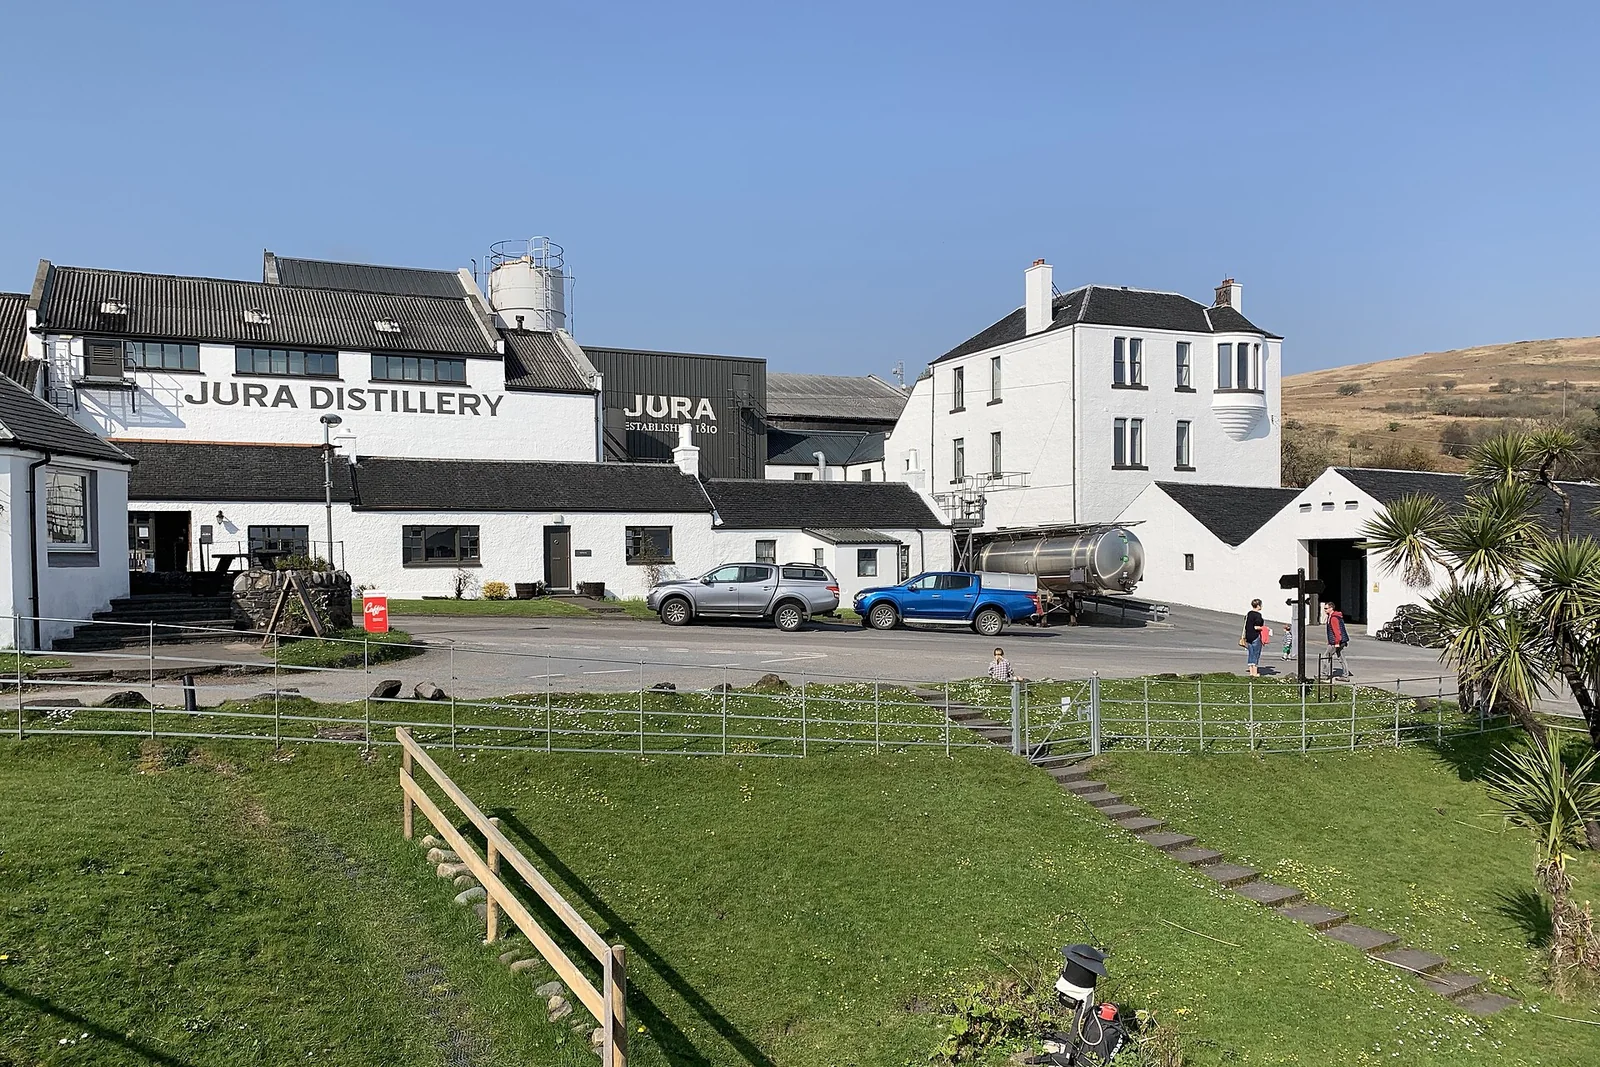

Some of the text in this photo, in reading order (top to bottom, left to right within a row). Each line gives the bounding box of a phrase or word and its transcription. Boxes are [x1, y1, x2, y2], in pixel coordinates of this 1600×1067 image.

[184, 381, 504, 417] JURA DISTILLERY
[623, 394, 717, 421] JURA
[625, 421, 718, 434] ESTABLISH 1810
